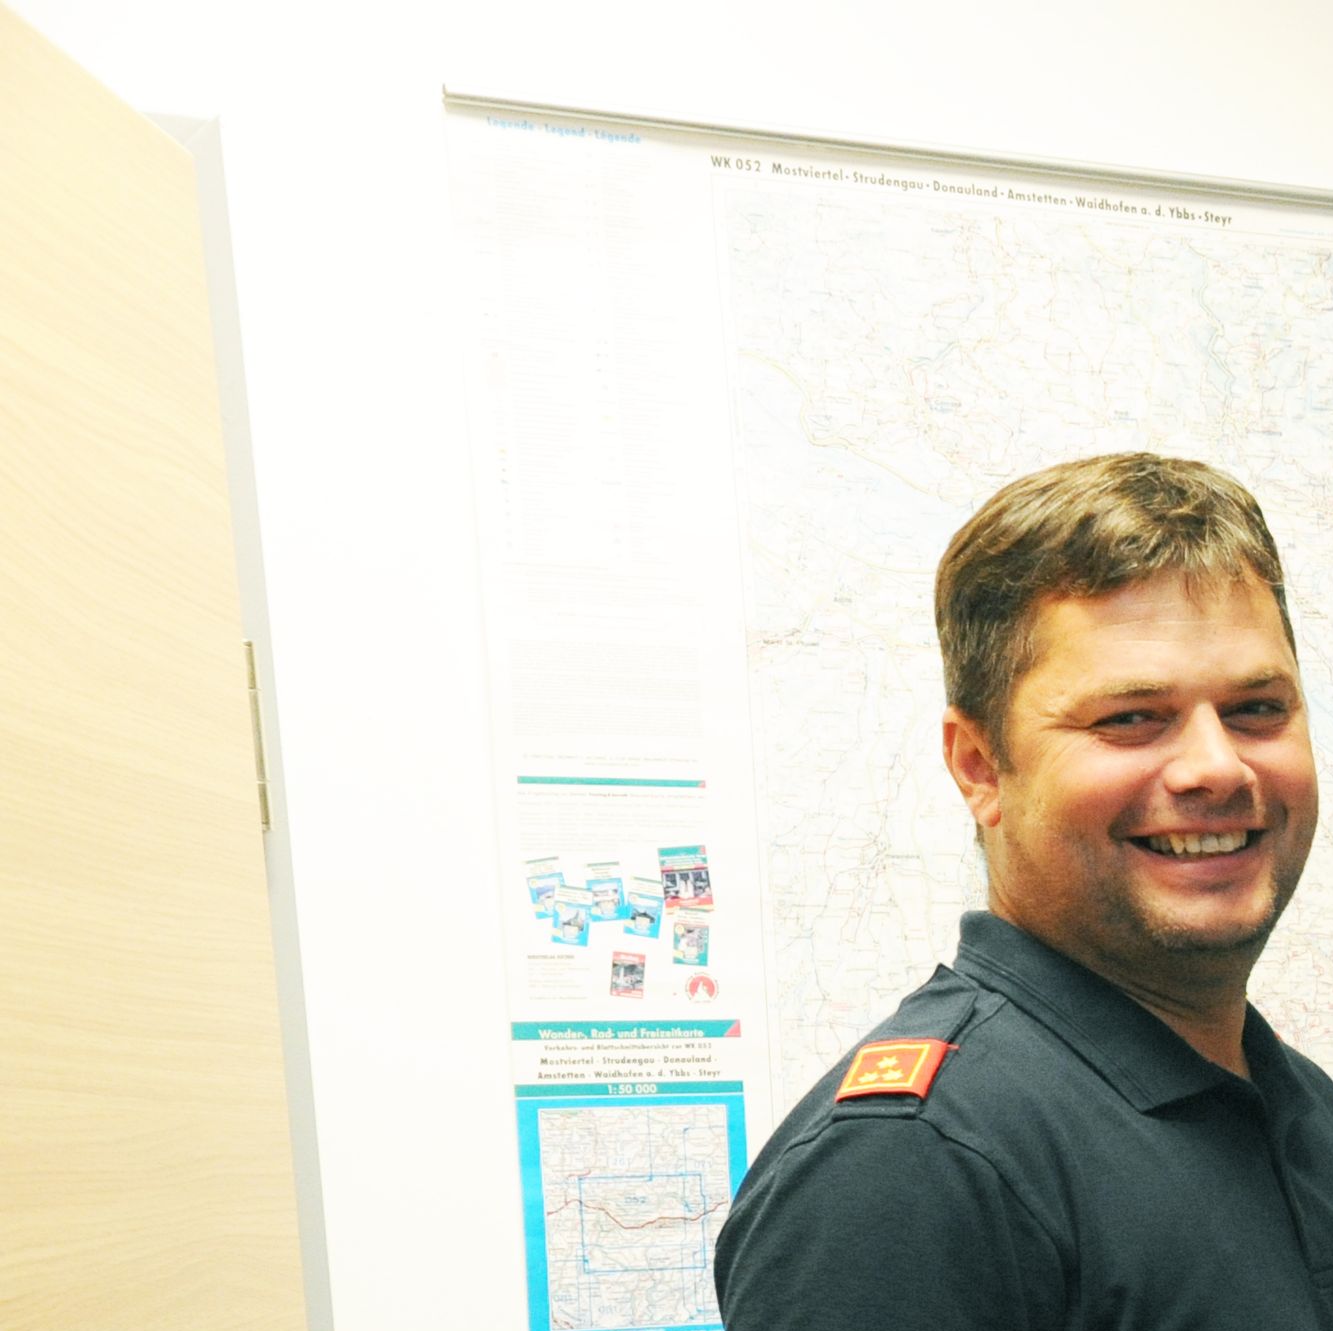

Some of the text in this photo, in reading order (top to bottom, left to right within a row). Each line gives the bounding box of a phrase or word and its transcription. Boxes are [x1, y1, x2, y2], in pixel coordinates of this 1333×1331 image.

[710, 155, 1232, 227] WK 052 Mostviertel Strudengau Donauland Amstetten Waidhofen a. d. Ybbs Steyr
[617, 1029, 637, 1039] und
[640, 1028, 704, 1039] Freizeitkarte
[540, 1055, 712, 1066] Mostviertel Strudengau Donauland
[537, 1070, 586, 1080] Amstetten
[594, 1070, 643, 1079] Waidhofen
[607, 1084, 657, 1094] 1:50 000
